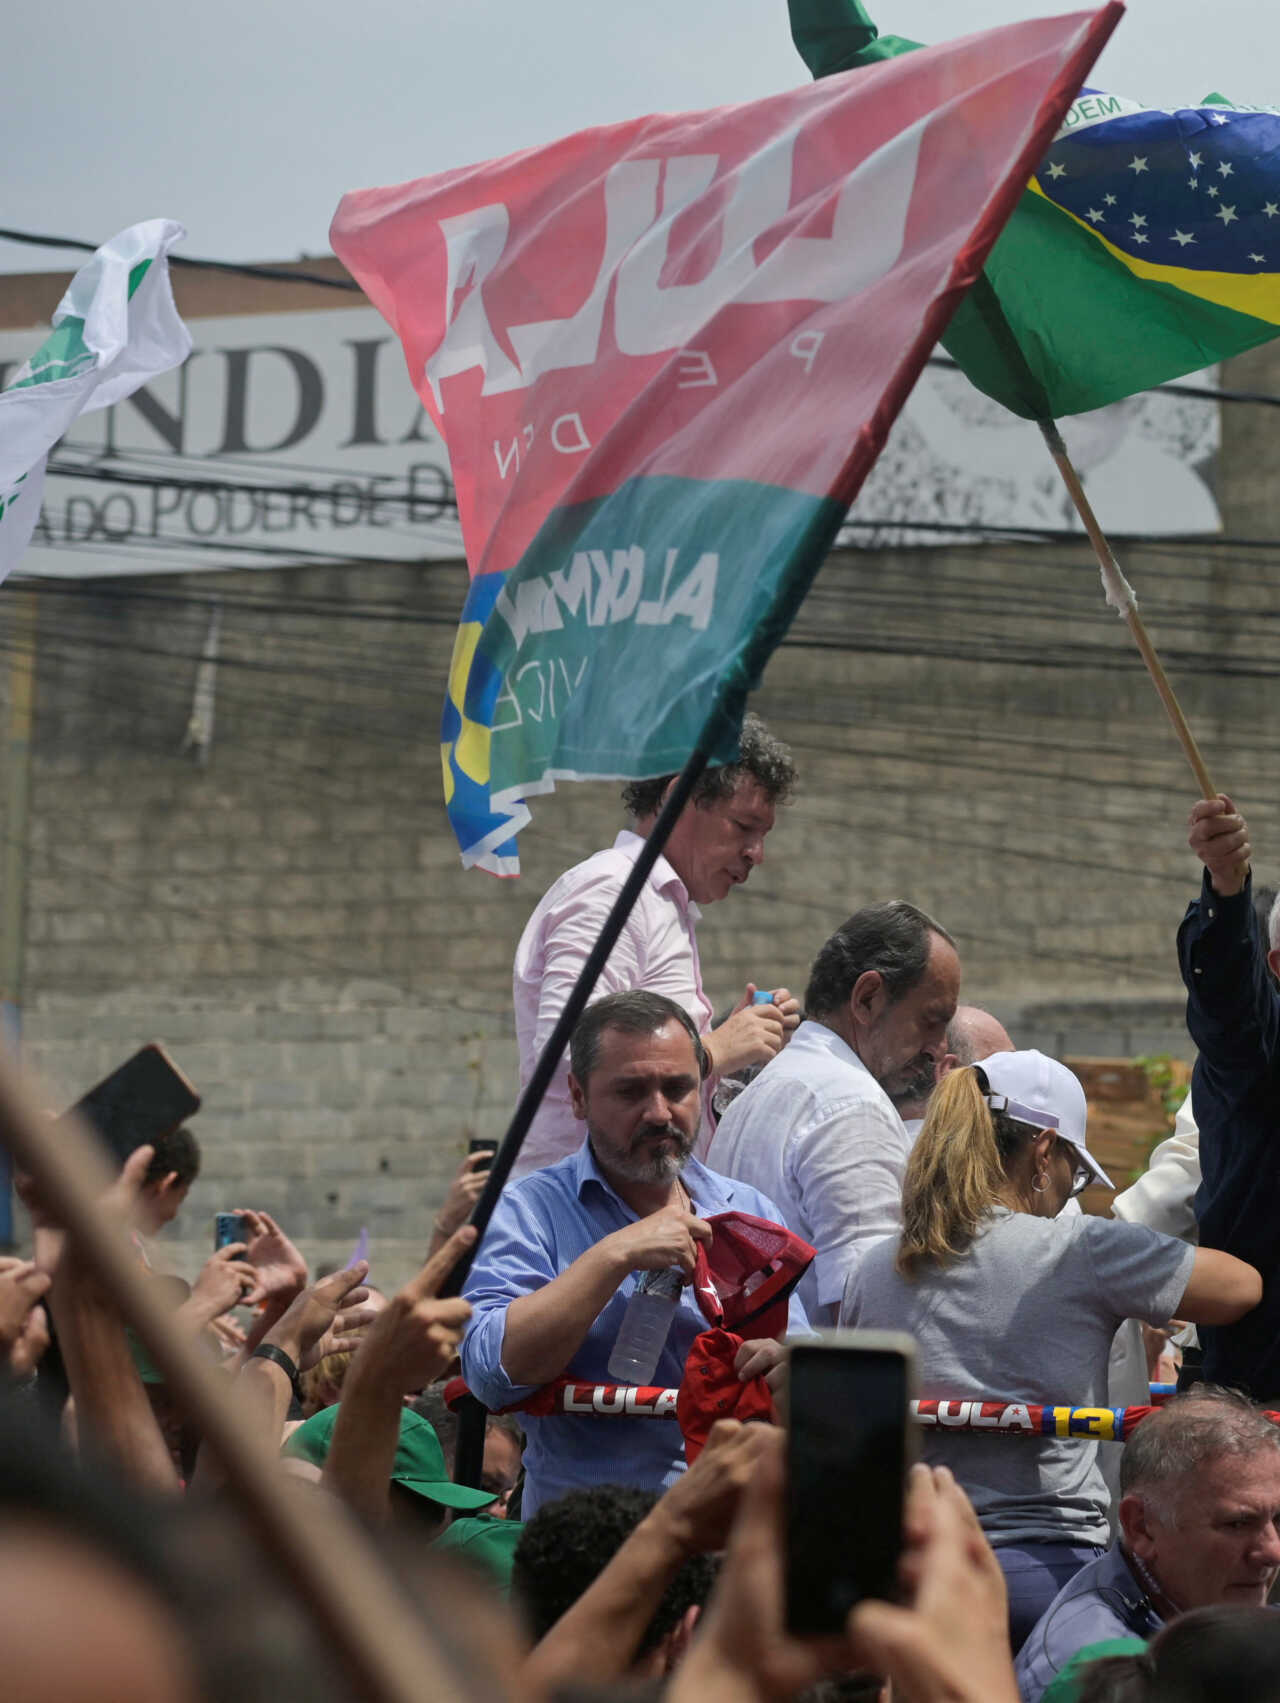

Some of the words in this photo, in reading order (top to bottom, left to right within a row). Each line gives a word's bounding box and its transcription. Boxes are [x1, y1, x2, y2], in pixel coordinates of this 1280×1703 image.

[1064, 96, 1121, 127] DEM
[152, 480, 318, 537] PODER
[409, 463, 459, 523] D
[563, 1384, 680, 1416] LULA
[909, 1399, 1034, 1430] LULA
[1052, 1406, 1115, 1441] 13
